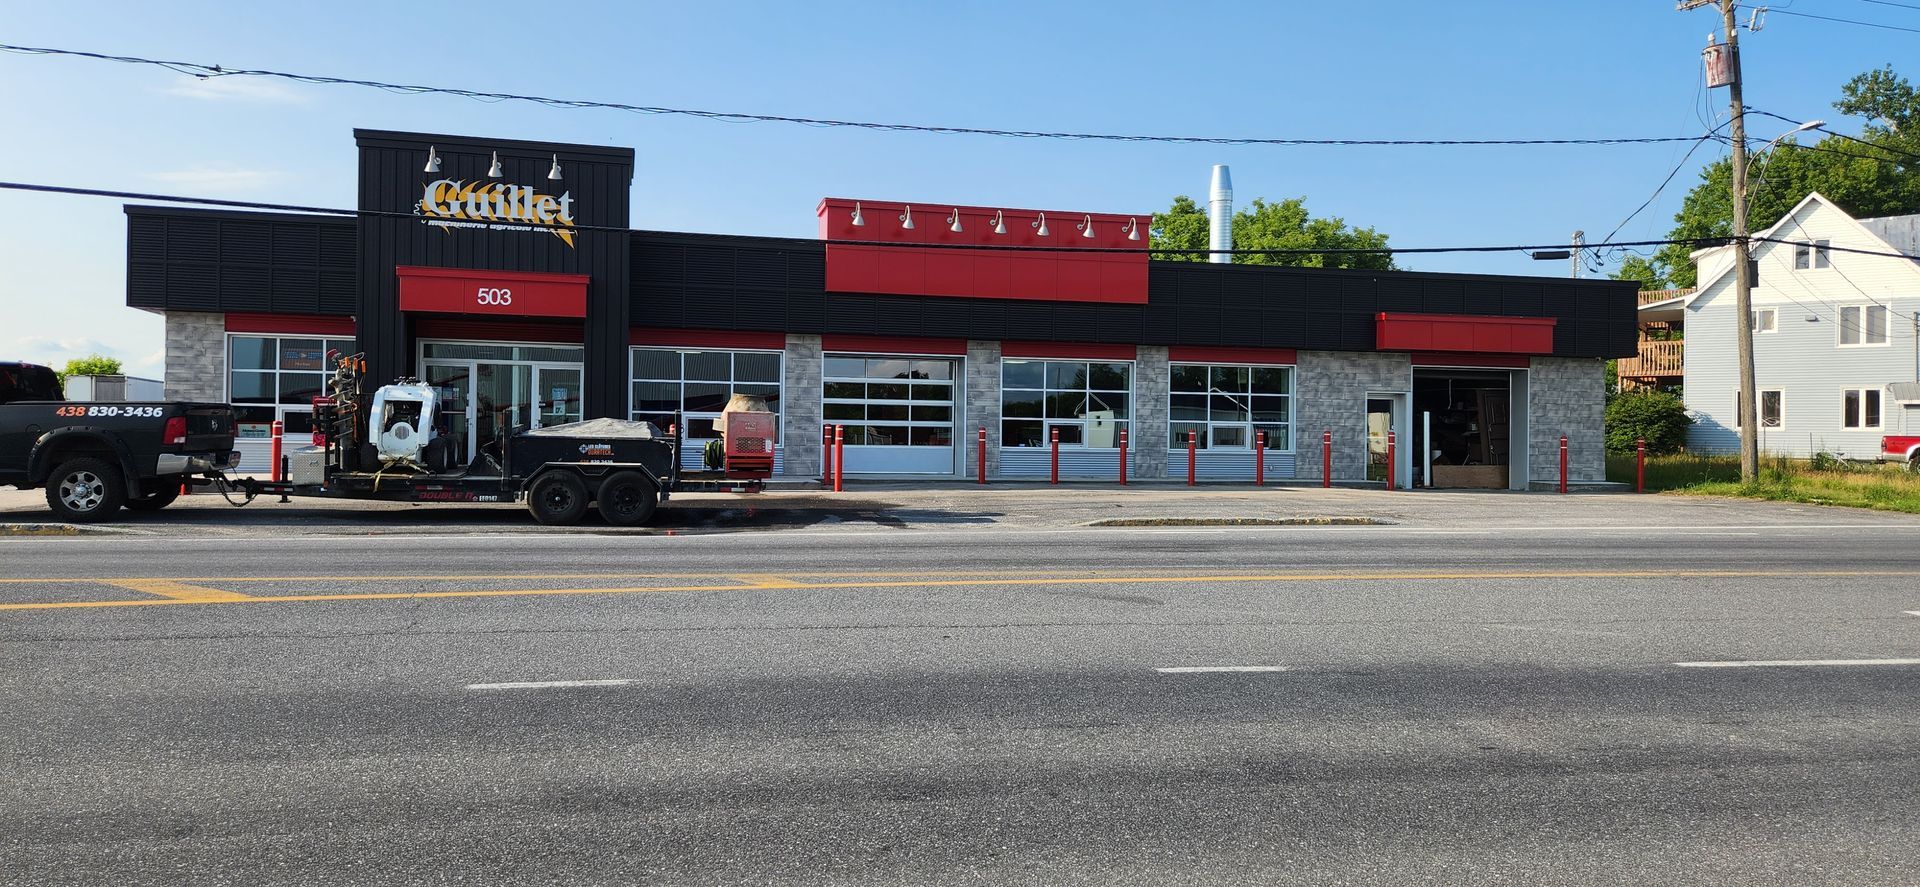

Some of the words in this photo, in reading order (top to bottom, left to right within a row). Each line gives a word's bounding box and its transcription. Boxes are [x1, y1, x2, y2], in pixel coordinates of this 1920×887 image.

[424, 180, 574, 222] Guillet
[477, 288, 512, 305] 503
[56, 406, 86, 416] 438
[88, 406, 163, 417] 830-3436
